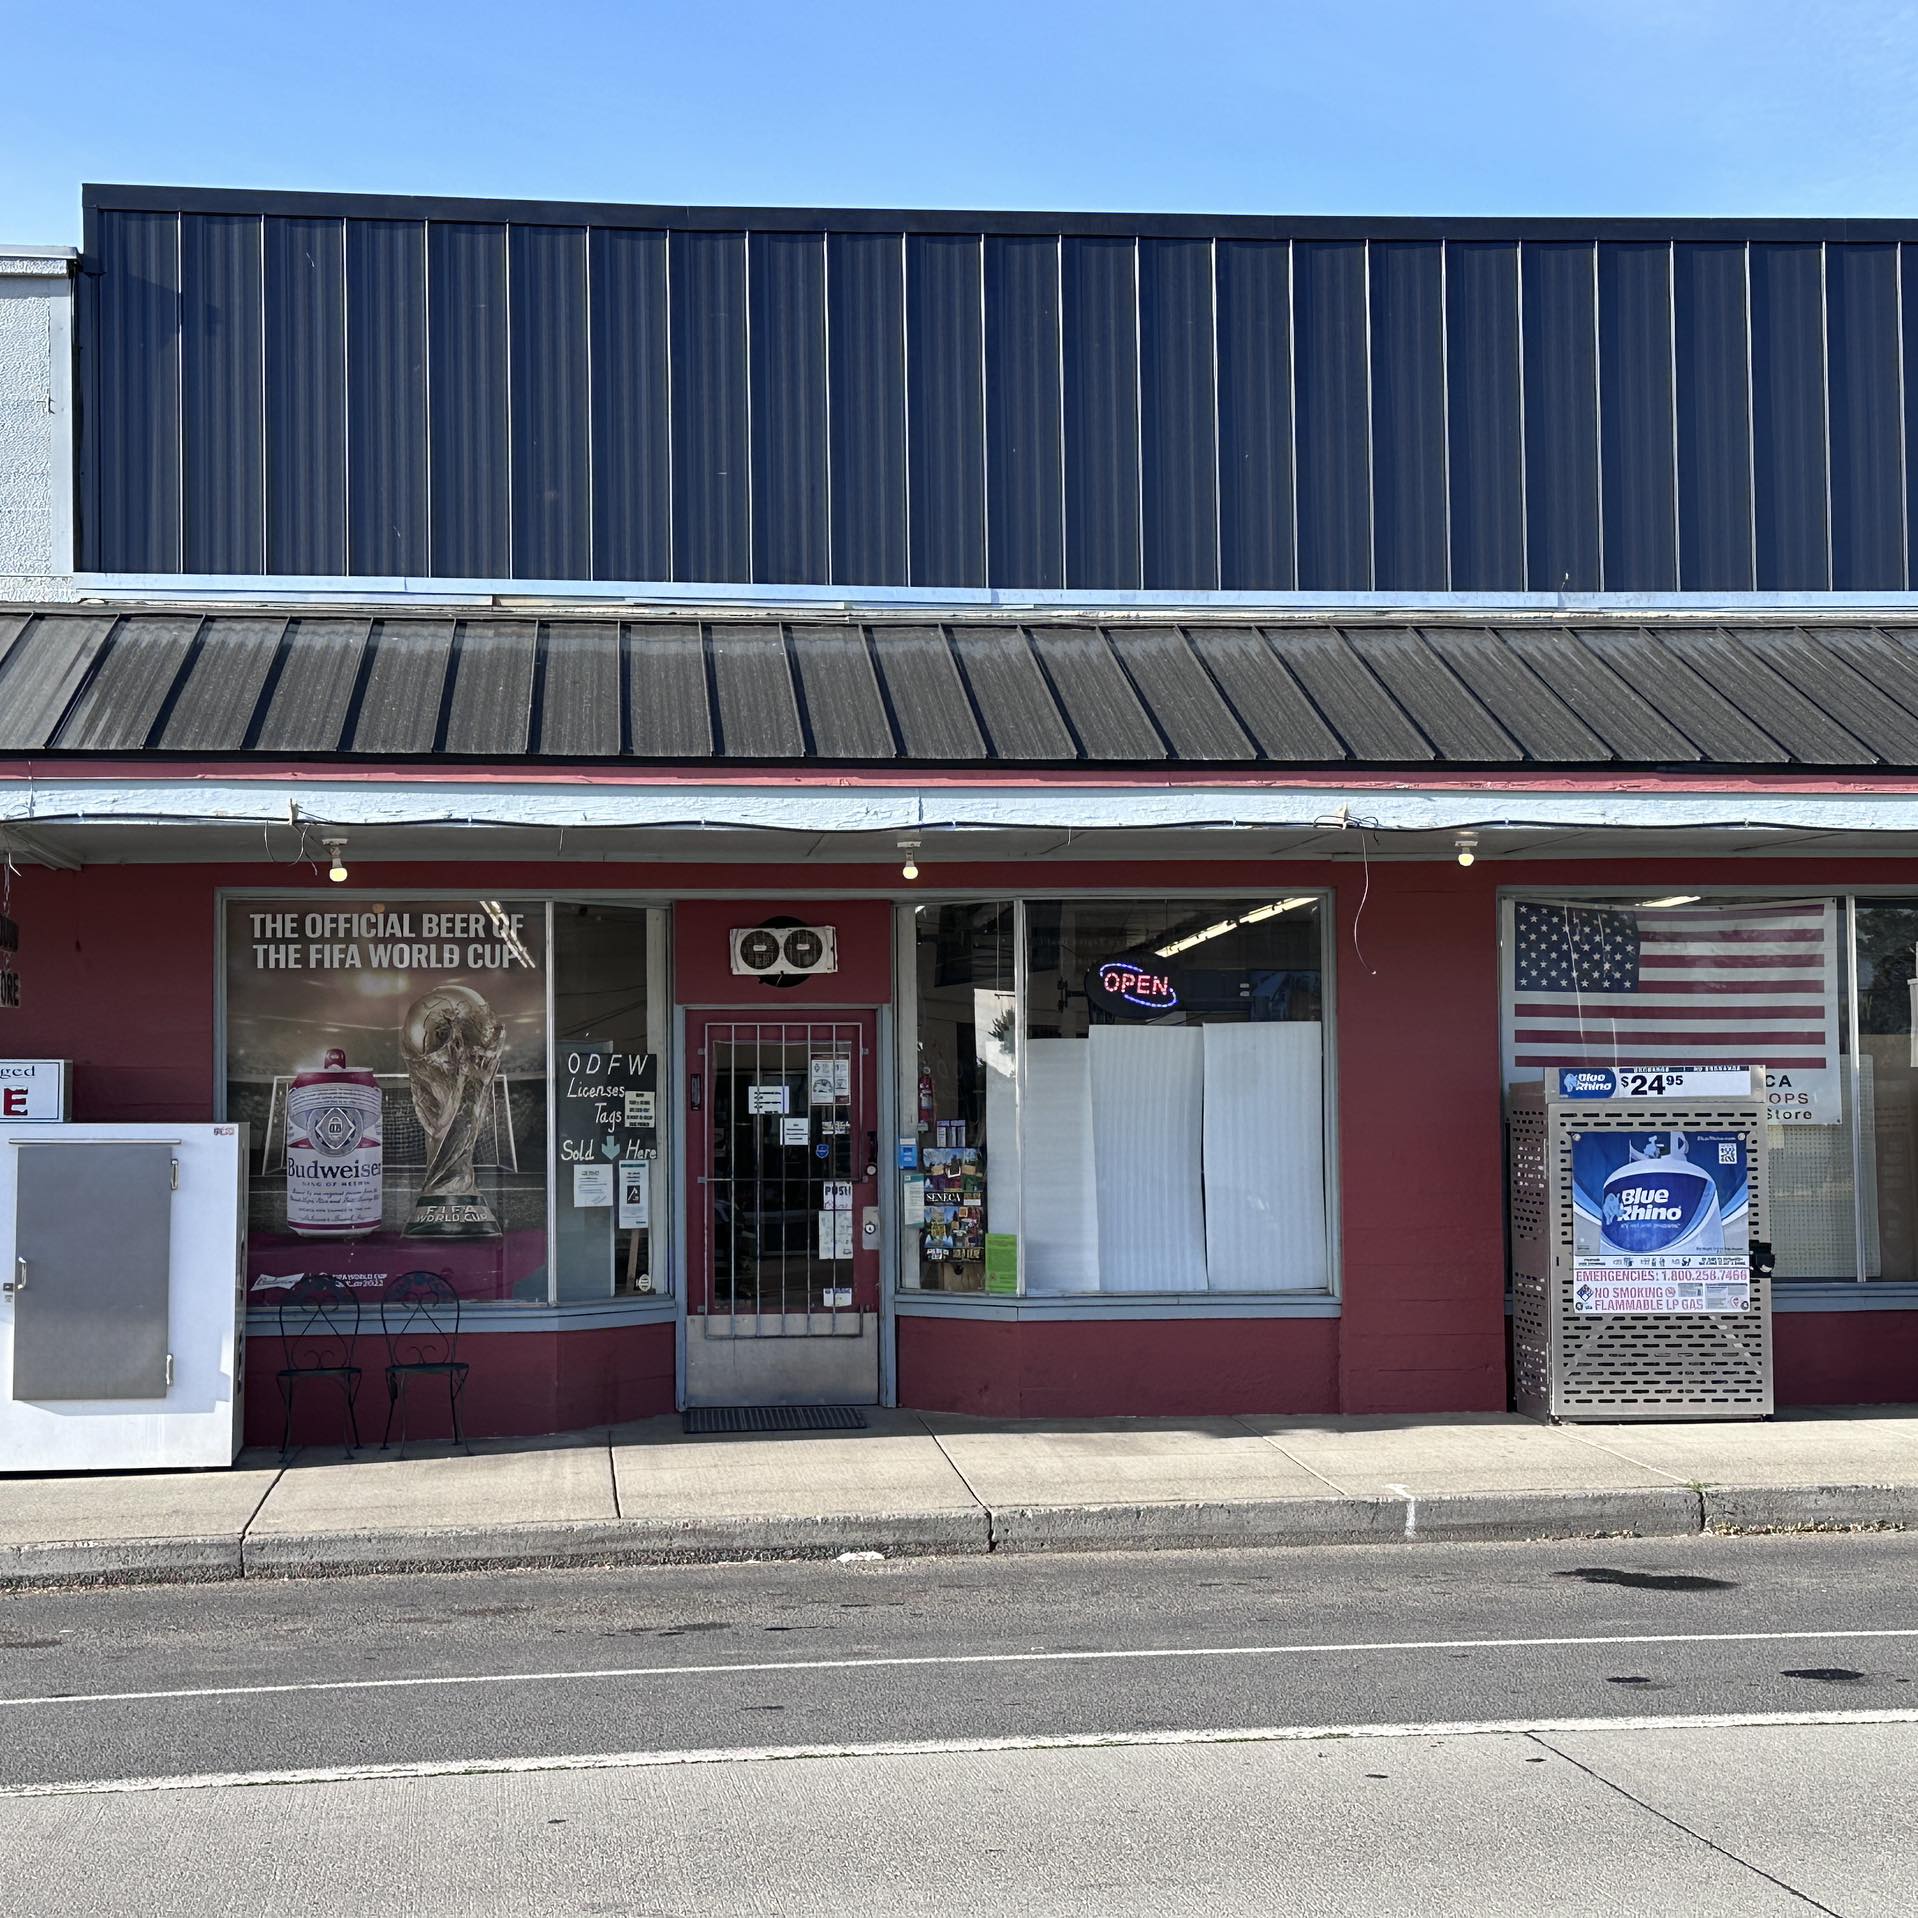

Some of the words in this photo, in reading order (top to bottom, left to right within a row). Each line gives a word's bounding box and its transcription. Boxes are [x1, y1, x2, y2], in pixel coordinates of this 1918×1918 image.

[250, 913, 299, 938] THE
[304, 913, 416, 938] OFFICIAL
[422, 913, 486, 938] BEER
[492, 913, 525, 938] OF
[252, 944, 302, 969] THE
[309, 944, 362, 969] FIFA
[369, 944, 460, 969] WORLD
[467, 943, 518, 969] CUP
[1104, 972, 1169, 996] OPEN
[566, 1077, 626, 1098] Licenses
[3, 1084, 29, 1116] E
[1769, 1092, 1809, 1104] OPS
[594, 1102, 623, 1133] Tags
[560, 1139, 595, 1161] Sold
[625, 1138, 657, 1160] Here
[926, 1191, 961, 1203] SENECA
[1621, 1187, 1670, 1205] Blue
[416, 1213, 460, 1223] WORLD
[426, 1205, 478, 1215] FIFA
[1617, 1204, 1682, 1221] Rhino
[1594, 1287, 1610, 1299] NO
[1613, 1286, 1663, 1299] SMOKING
[1594, 1300, 1664, 1311] FLAMMABLE
[1666, 1300, 1680, 1311] LP
[1682, 1299, 1704, 1311] GAS
